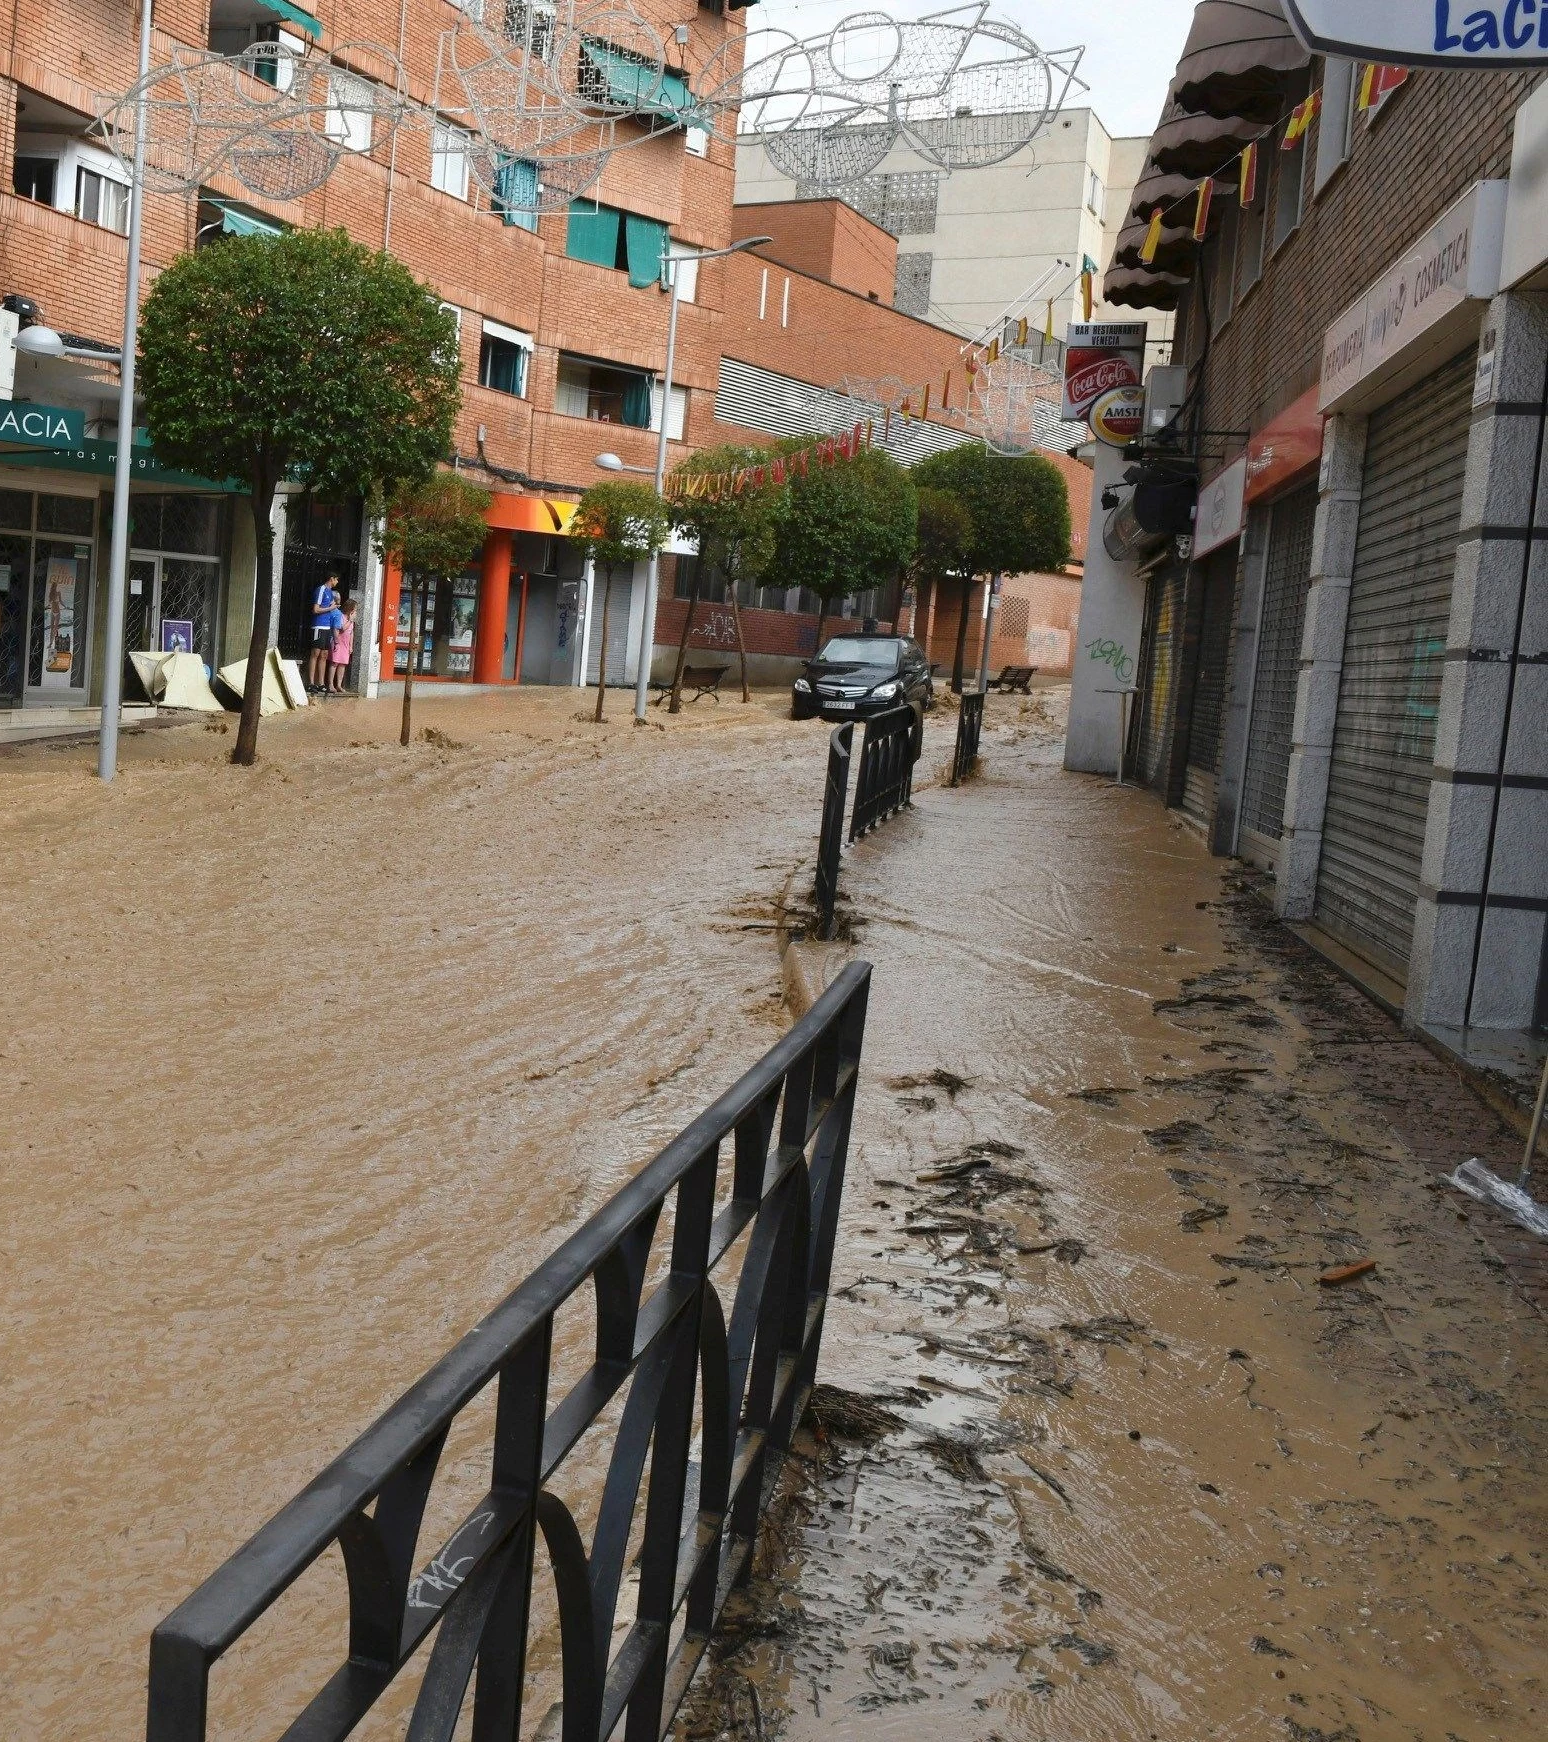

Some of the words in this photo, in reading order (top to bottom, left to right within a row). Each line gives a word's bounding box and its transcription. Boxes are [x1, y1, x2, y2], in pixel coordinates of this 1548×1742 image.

[1413, 228, 1468, 308] COSMETICA
[1075, 325, 1089, 335] BAR
[1092, 325, 1140, 335] RESTAURANTE
[1092, 336, 1120, 345] VENECIA
[1072, 362, 1128, 401] Coca-Cola
